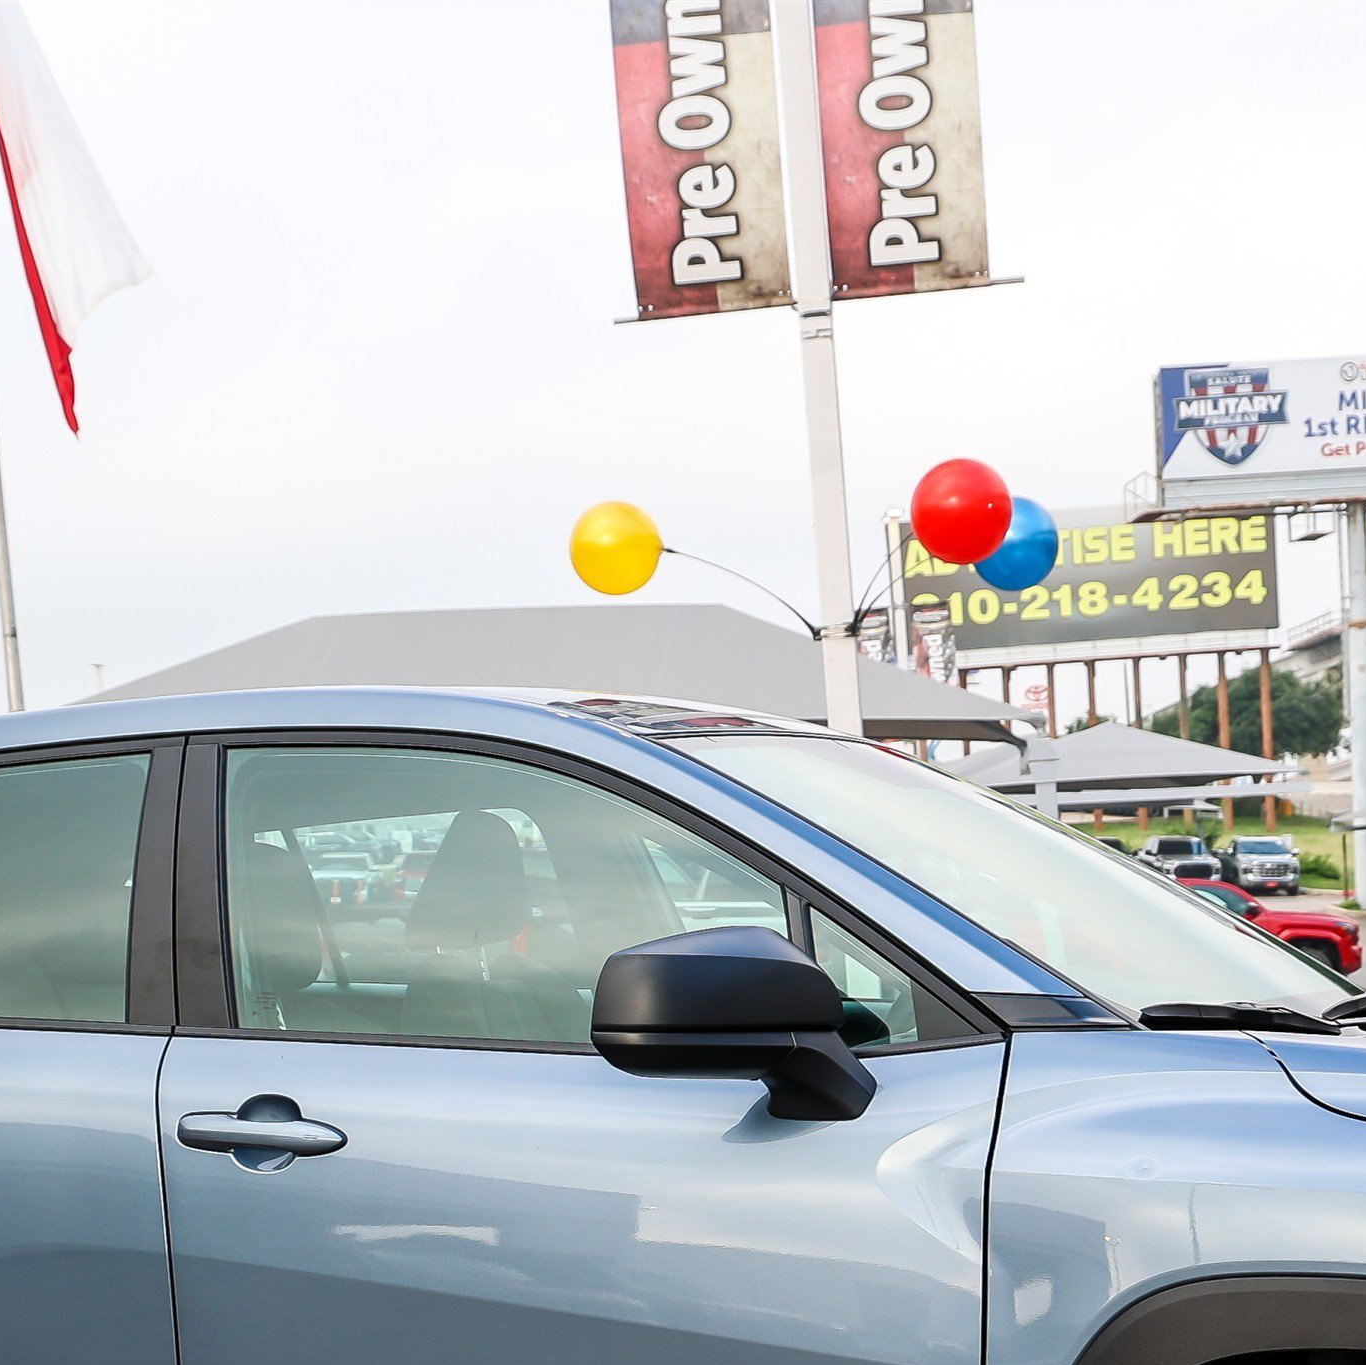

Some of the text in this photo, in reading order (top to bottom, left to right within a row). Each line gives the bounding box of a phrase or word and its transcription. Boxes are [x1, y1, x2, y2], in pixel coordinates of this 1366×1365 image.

[870, 143, 941, 267] Pre
[672, 162, 742, 285] Pre
[1178, 394, 1283, 420] MILITARY
[1303, 416, 1339, 438] 1st
[1320, 441, 1352, 458] Get
[1153, 515, 1269, 559] HERE
